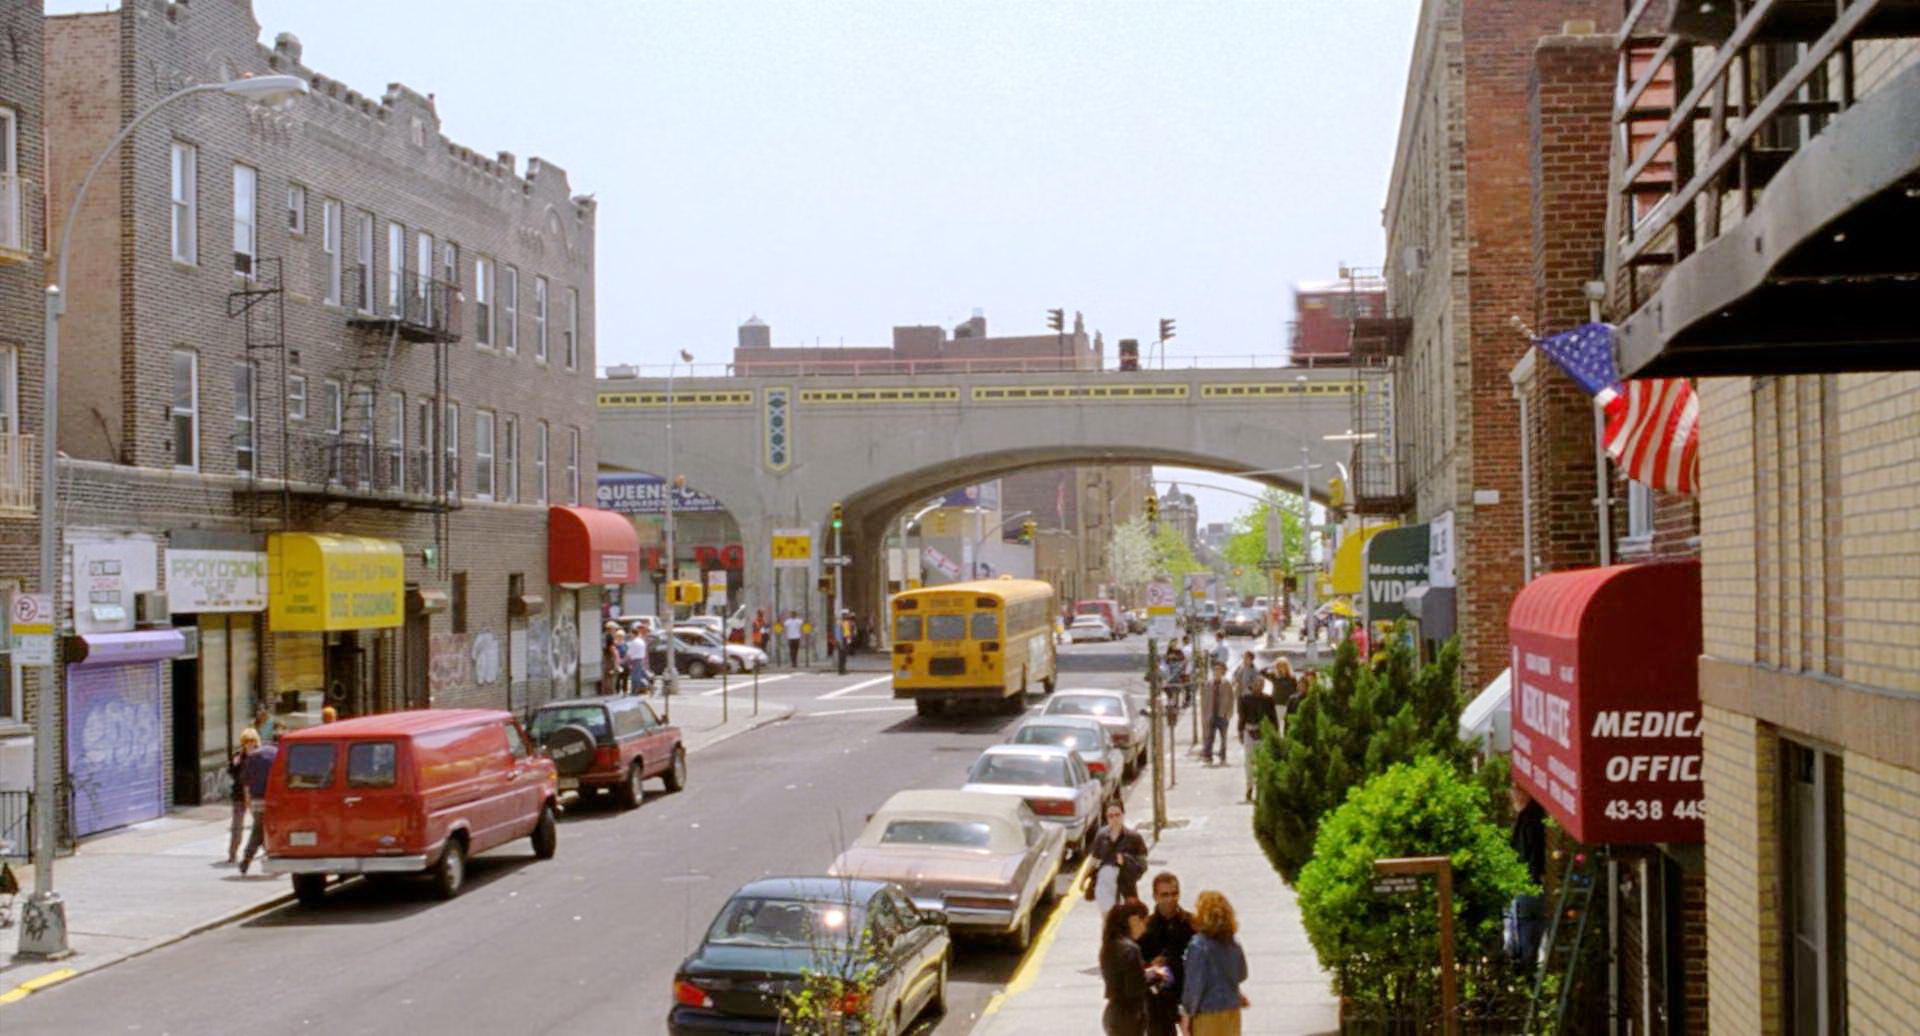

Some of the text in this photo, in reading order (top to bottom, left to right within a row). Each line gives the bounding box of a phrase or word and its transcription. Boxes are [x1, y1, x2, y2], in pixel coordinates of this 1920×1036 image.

[1370, 580, 1429, 603] VID
[1605, 755, 1702, 782] OFFIC
[1604, 800, 1663, 820] 43-38
